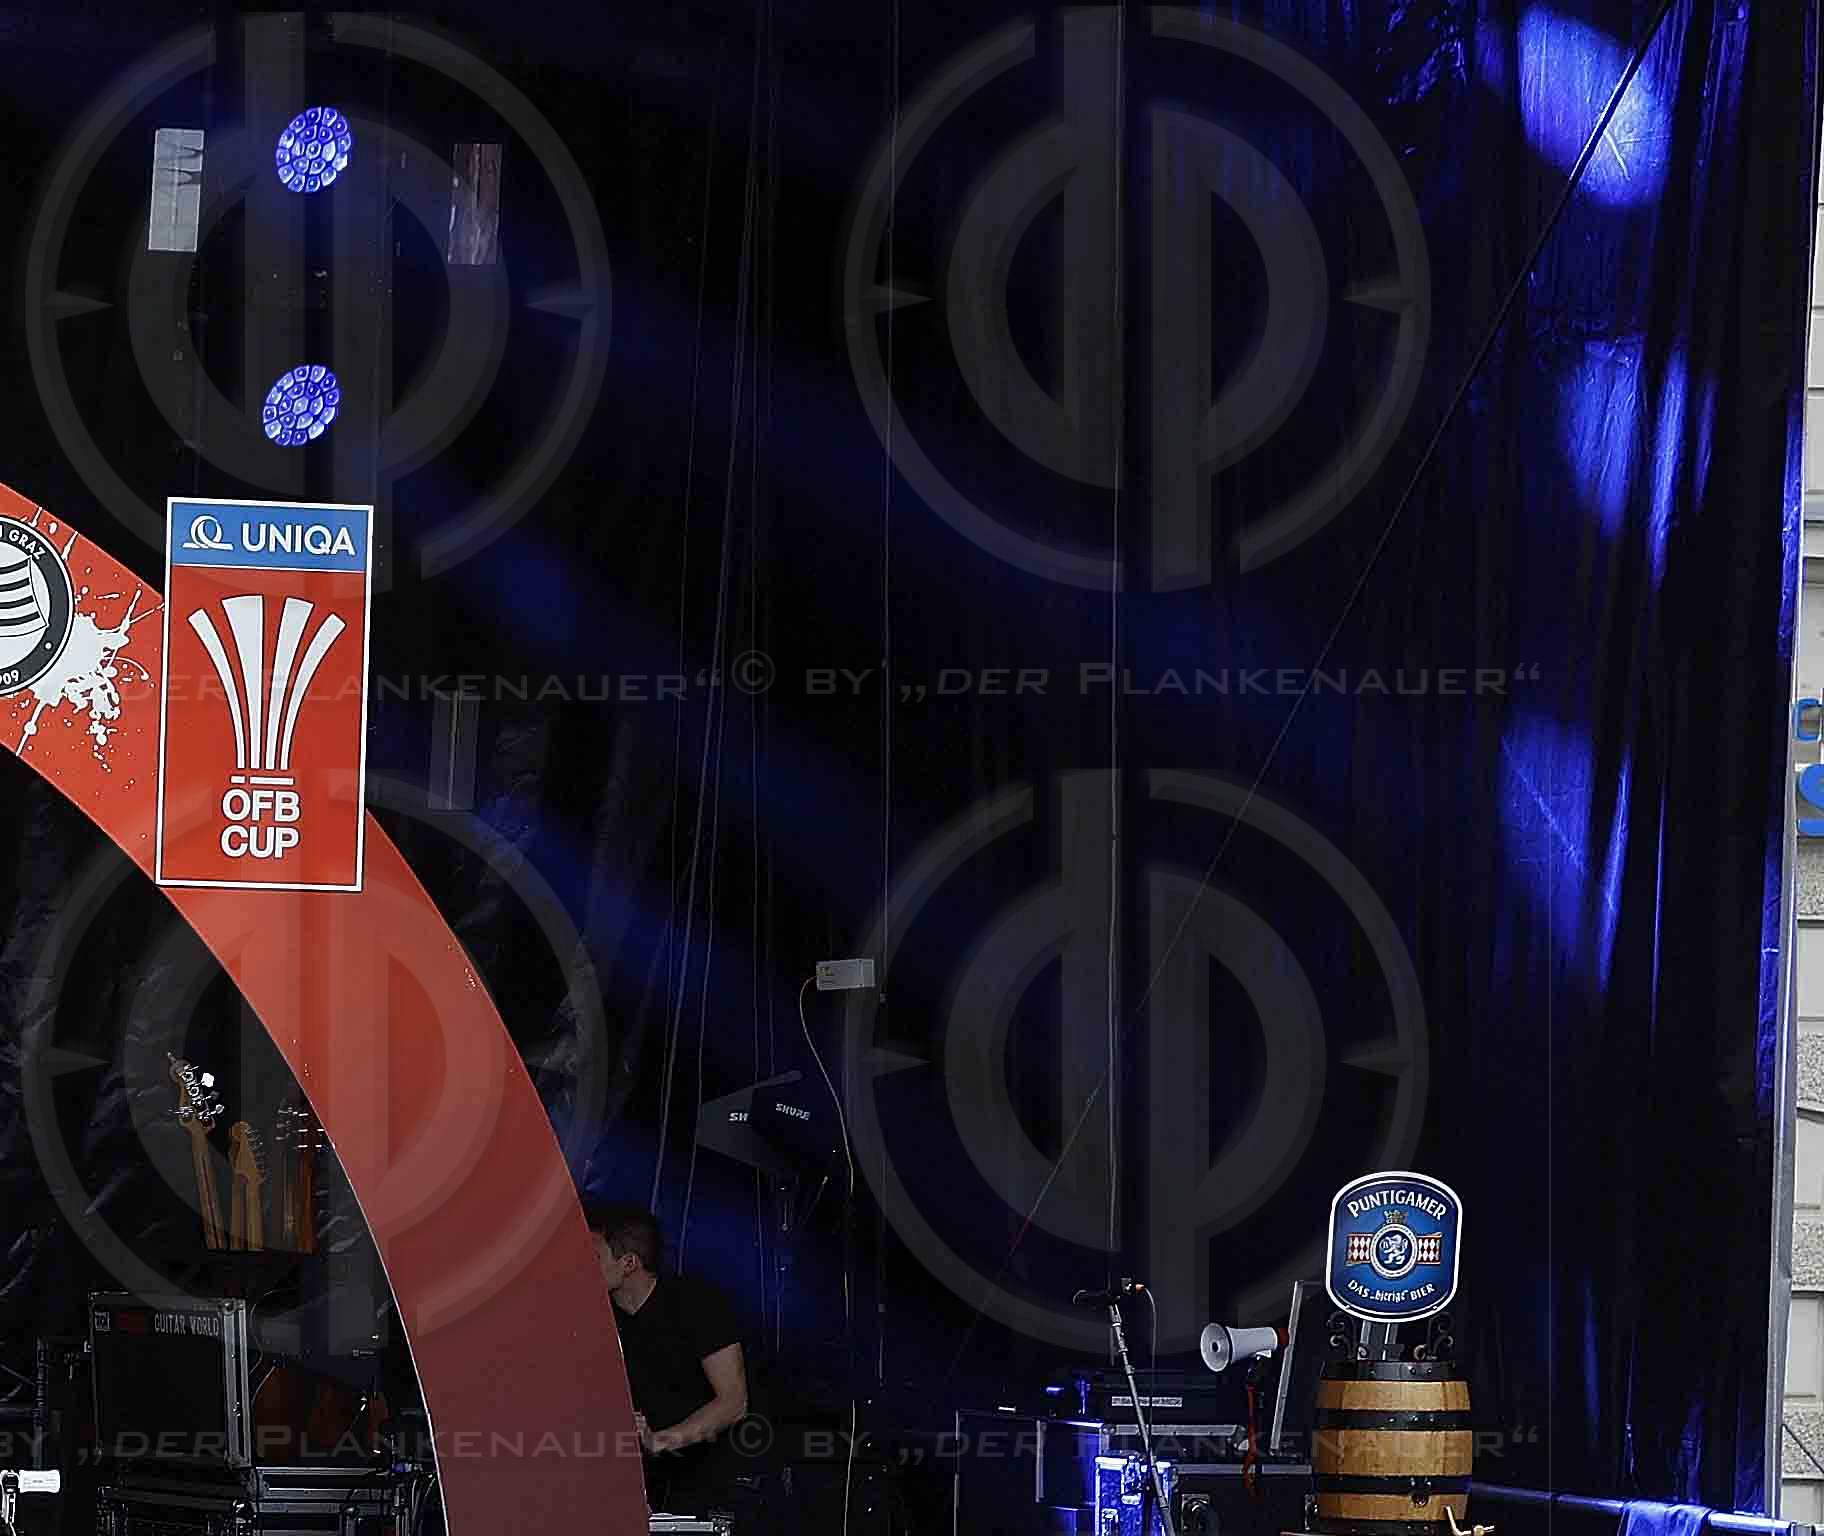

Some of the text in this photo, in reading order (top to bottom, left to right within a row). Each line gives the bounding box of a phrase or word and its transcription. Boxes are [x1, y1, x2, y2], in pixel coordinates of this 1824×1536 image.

[8, 530, 47, 560] GRAZ
[241, 522, 357, 556] UNIQA
[220, 825, 300, 858] CUP
[1346, 1189, 1447, 1221] PUNTIGAMER
[1347, 1279, 1370, 1299] DAS
[1409, 1283, 1436, 1301] BIER
[154, 1313, 219, 1337] GUITAR WORLD
